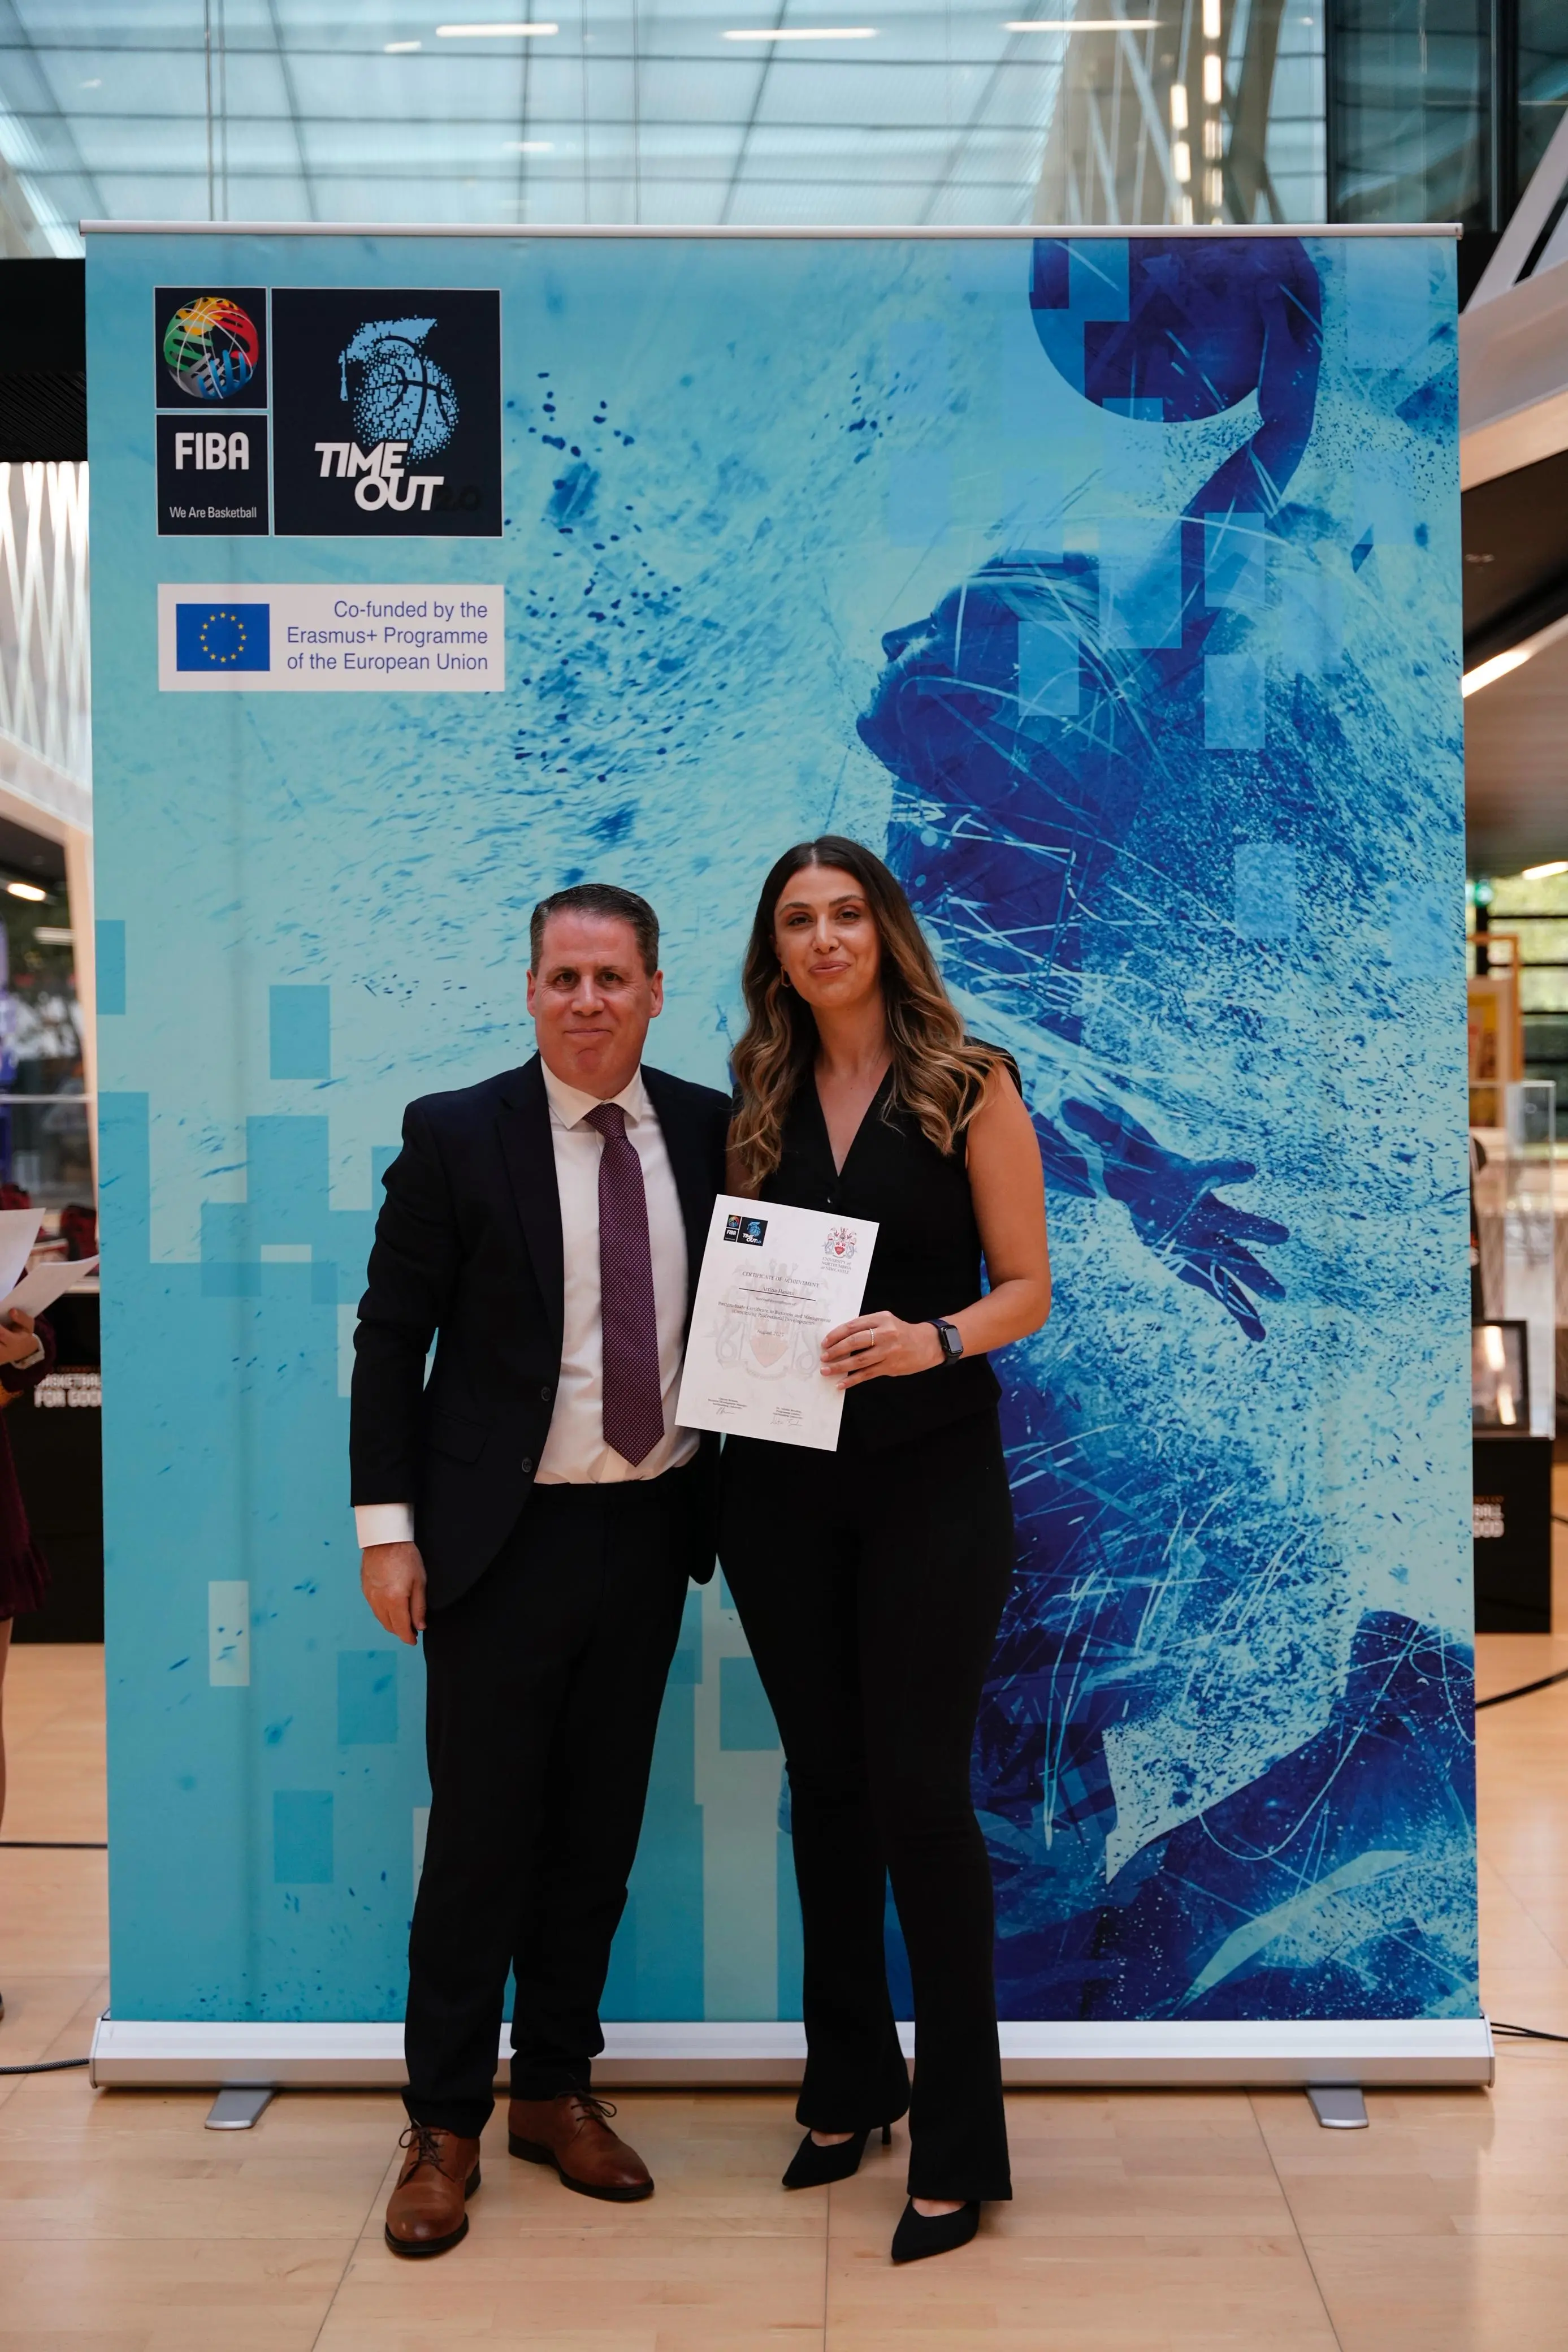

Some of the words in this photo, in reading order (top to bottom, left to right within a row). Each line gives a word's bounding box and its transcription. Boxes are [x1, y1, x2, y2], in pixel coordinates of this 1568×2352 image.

[175, 431, 249, 470] FIBA
[314, 442, 408, 477] TIME
[354, 475, 444, 511] OUT
[170, 506, 186, 518] We
[189, 506, 206, 518] Are
[208, 506, 257, 518] Basketball
[334, 600, 427, 618] Co-funded
[434, 601, 454, 621] by
[461, 602, 488, 617] the
[288, 626, 378, 643] Erasmus+
[384, 627, 488, 647] Programme
[287, 653, 304, 669] of
[310, 654, 337, 669] the
[344, 654, 430, 673] European
[438, 654, 488, 670] Union
[742, 1272, 774, 1281] CERTIFICATE
[785, 1278, 819, 1288] ACHIEVEMENT
